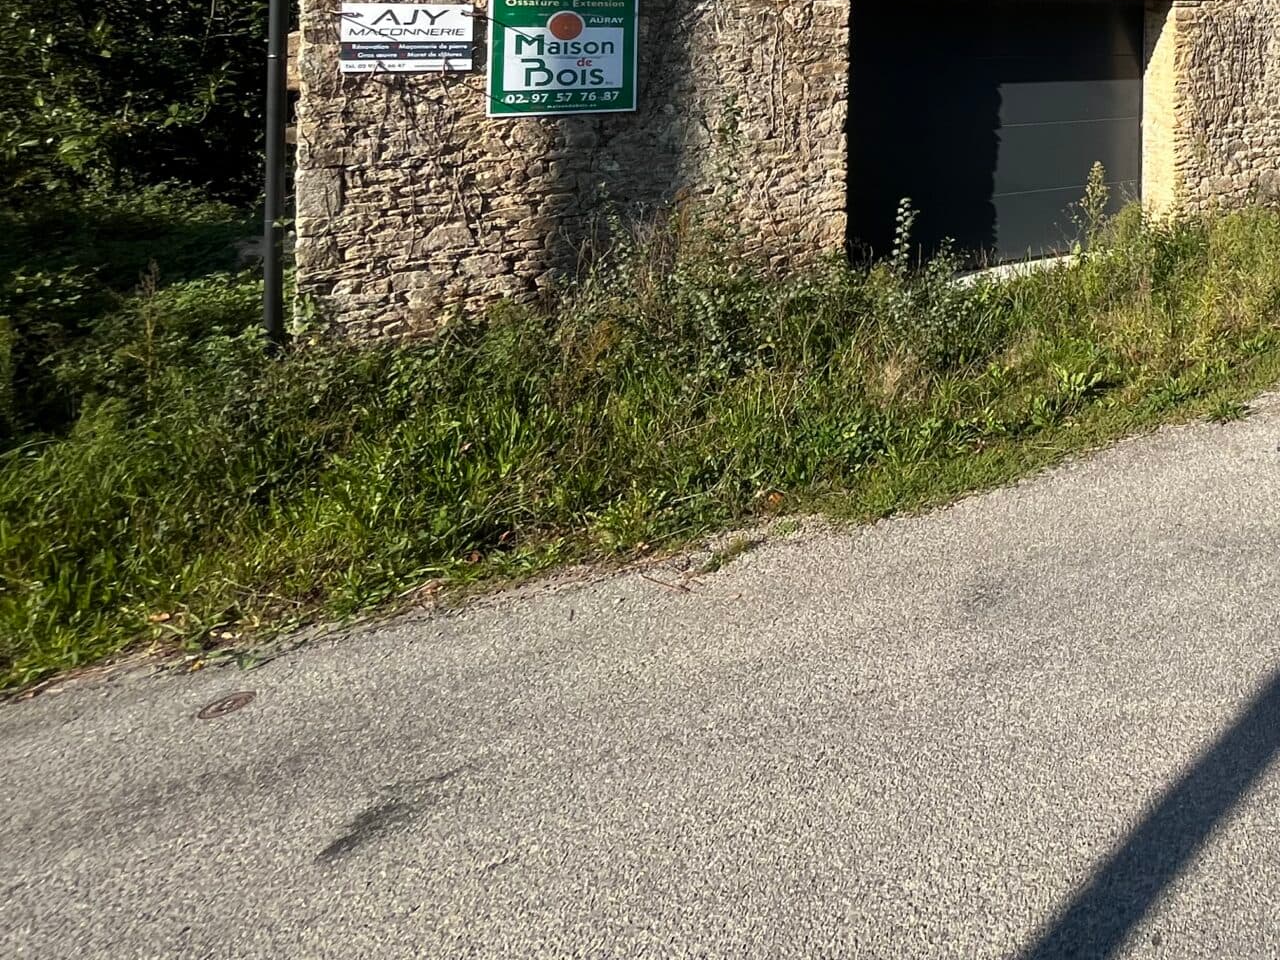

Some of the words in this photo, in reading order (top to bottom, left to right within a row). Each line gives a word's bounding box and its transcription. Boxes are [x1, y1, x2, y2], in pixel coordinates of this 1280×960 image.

[573, 0, 625, 8] Extension
[370, 9, 450, 25] AJY
[515, 34, 615, 56] Maison
[576, 57, 593, 67] de
[521, 58, 604, 87] Bois
[531, 93, 549, 103] 97
[555, 92, 573, 102] 57
[580, 91, 597, 101] 76
[603, 90, 620, 100] 87
